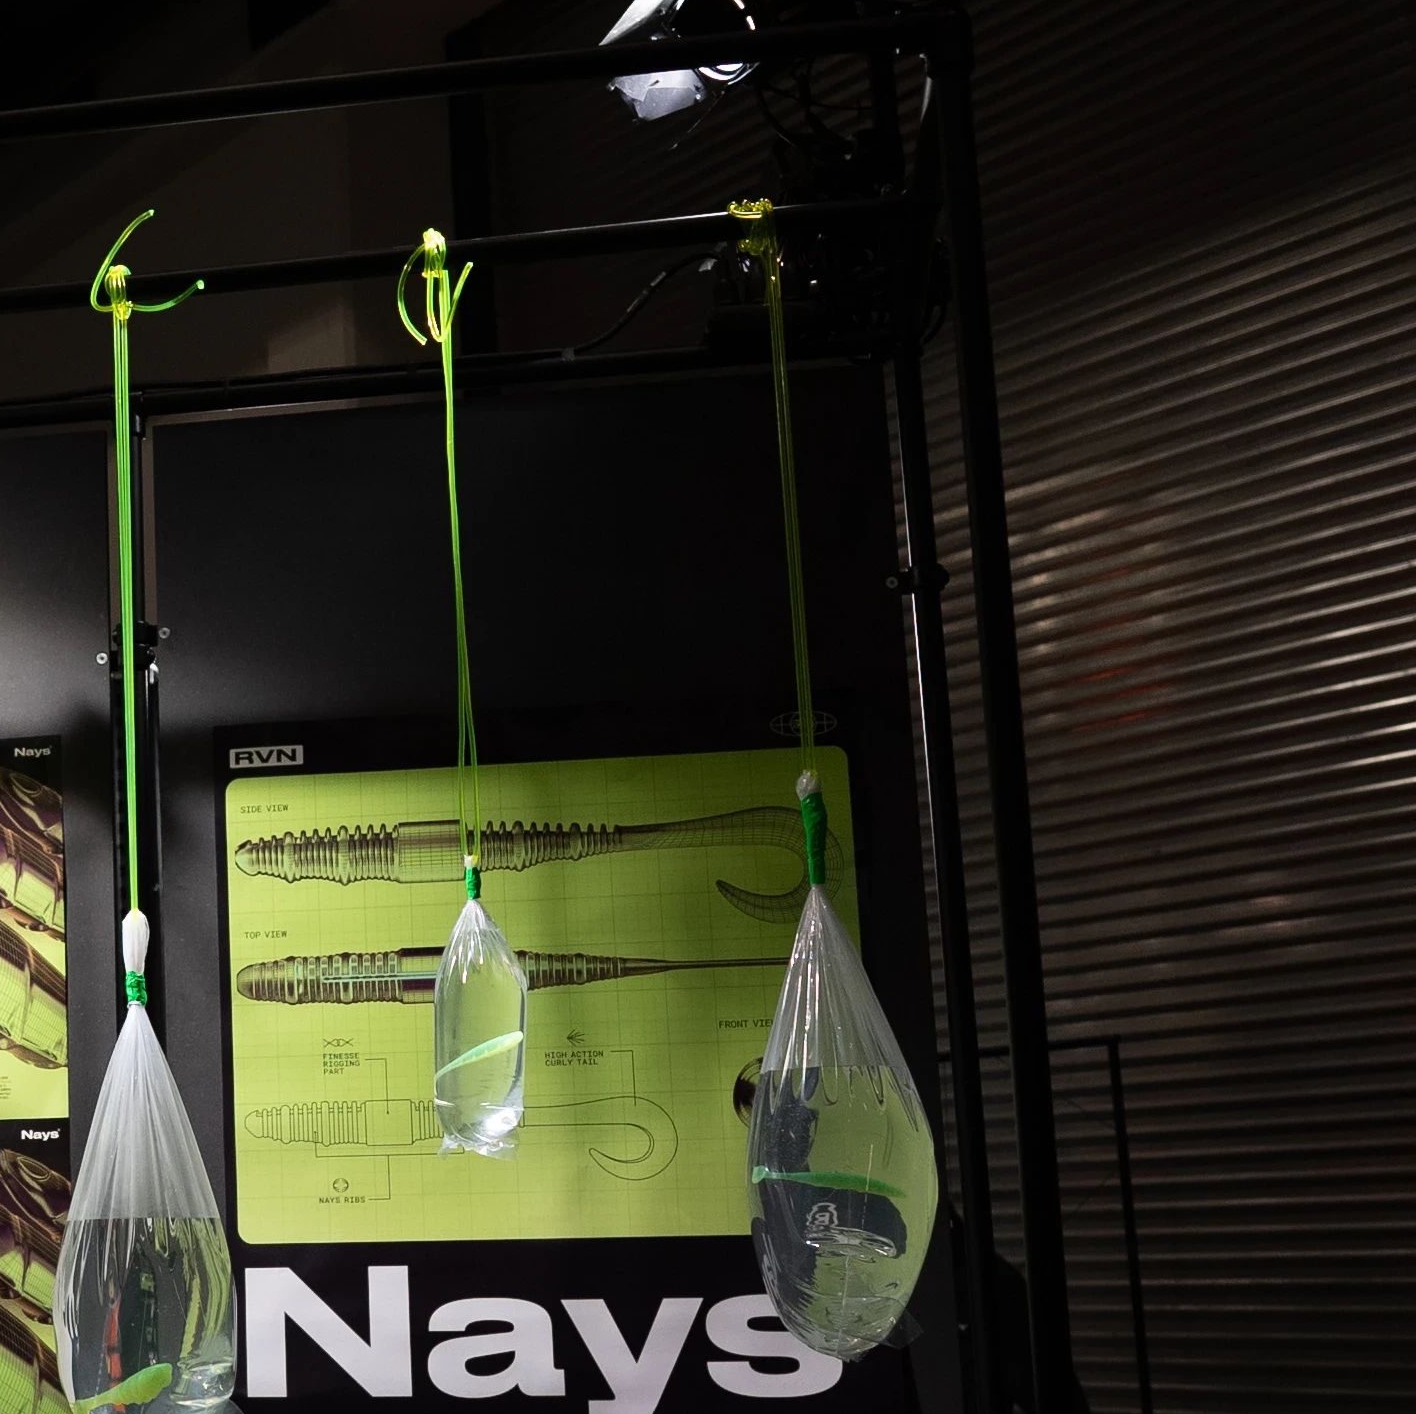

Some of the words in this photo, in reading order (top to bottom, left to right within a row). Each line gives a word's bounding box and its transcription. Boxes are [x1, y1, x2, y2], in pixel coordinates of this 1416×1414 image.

[14, 747, 51, 757] Nays
[235, 748, 297, 765] RVN
[266, 804, 289, 812] VIEW
[244, 931, 261, 939] TOP
[264, 930, 287, 938] VIEW
[718, 1020, 749, 1028] FRONT
[544, 1051, 567, 1059] HIGH
[571, 1050, 604, 1058] ACTION
[577, 1058, 598, 1066] TAIL
[21, 1129, 60, 1141] Nays
[344, 1195, 366, 1203] RIBS
